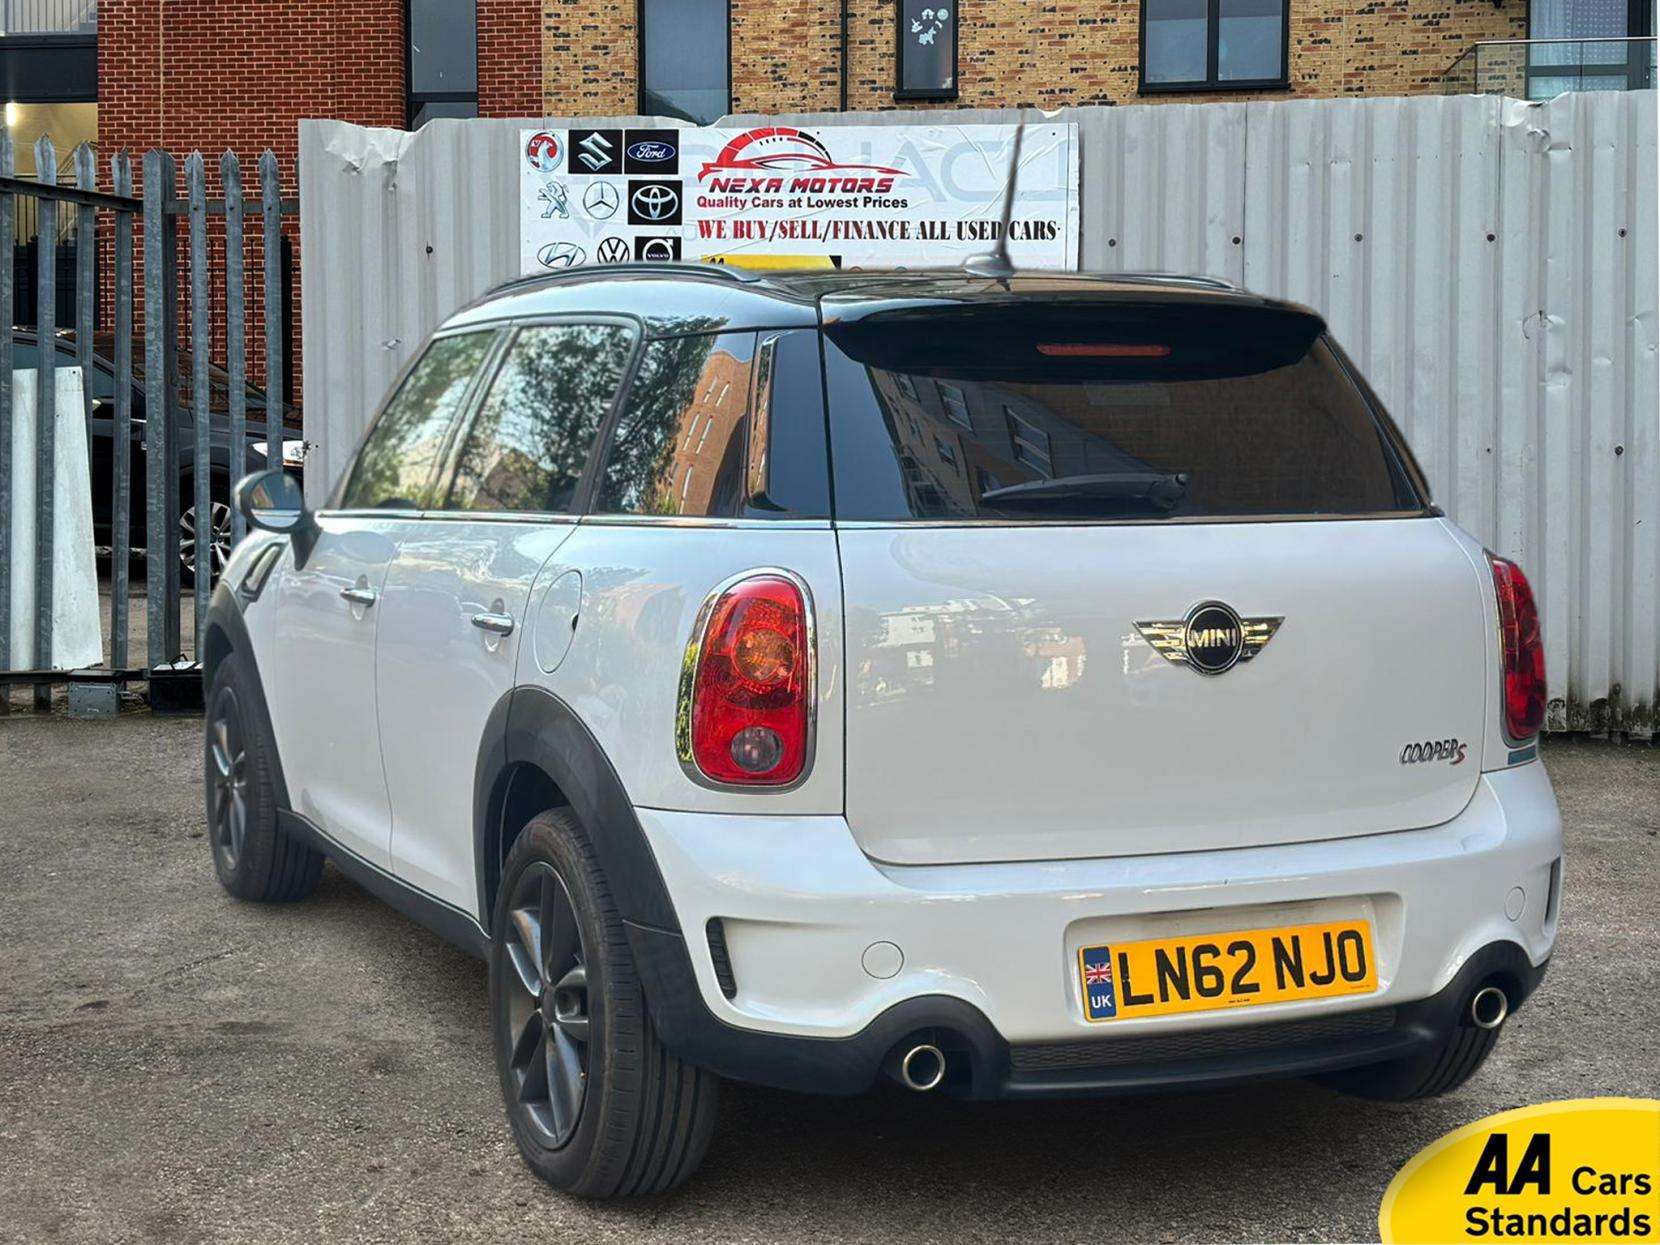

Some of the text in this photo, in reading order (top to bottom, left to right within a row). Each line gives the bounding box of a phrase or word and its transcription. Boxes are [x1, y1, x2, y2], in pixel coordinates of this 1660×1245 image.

[636, 144, 666, 158] Ford
[709, 178, 894, 194] NEXA MOTORS
[697, 195, 908, 209] Quality Cars at Lowest Prices
[698, 220, 727, 240] WE
[917, 220, 951, 240] ALL
[957, 220, 1003, 241] USED
[1009, 220, 1056, 241] CARS
[1189, 628, 1237, 648] MINI
[1117, 929, 1367, 1007] LN62 NJO
[1091, 994, 1112, 1009] UK
